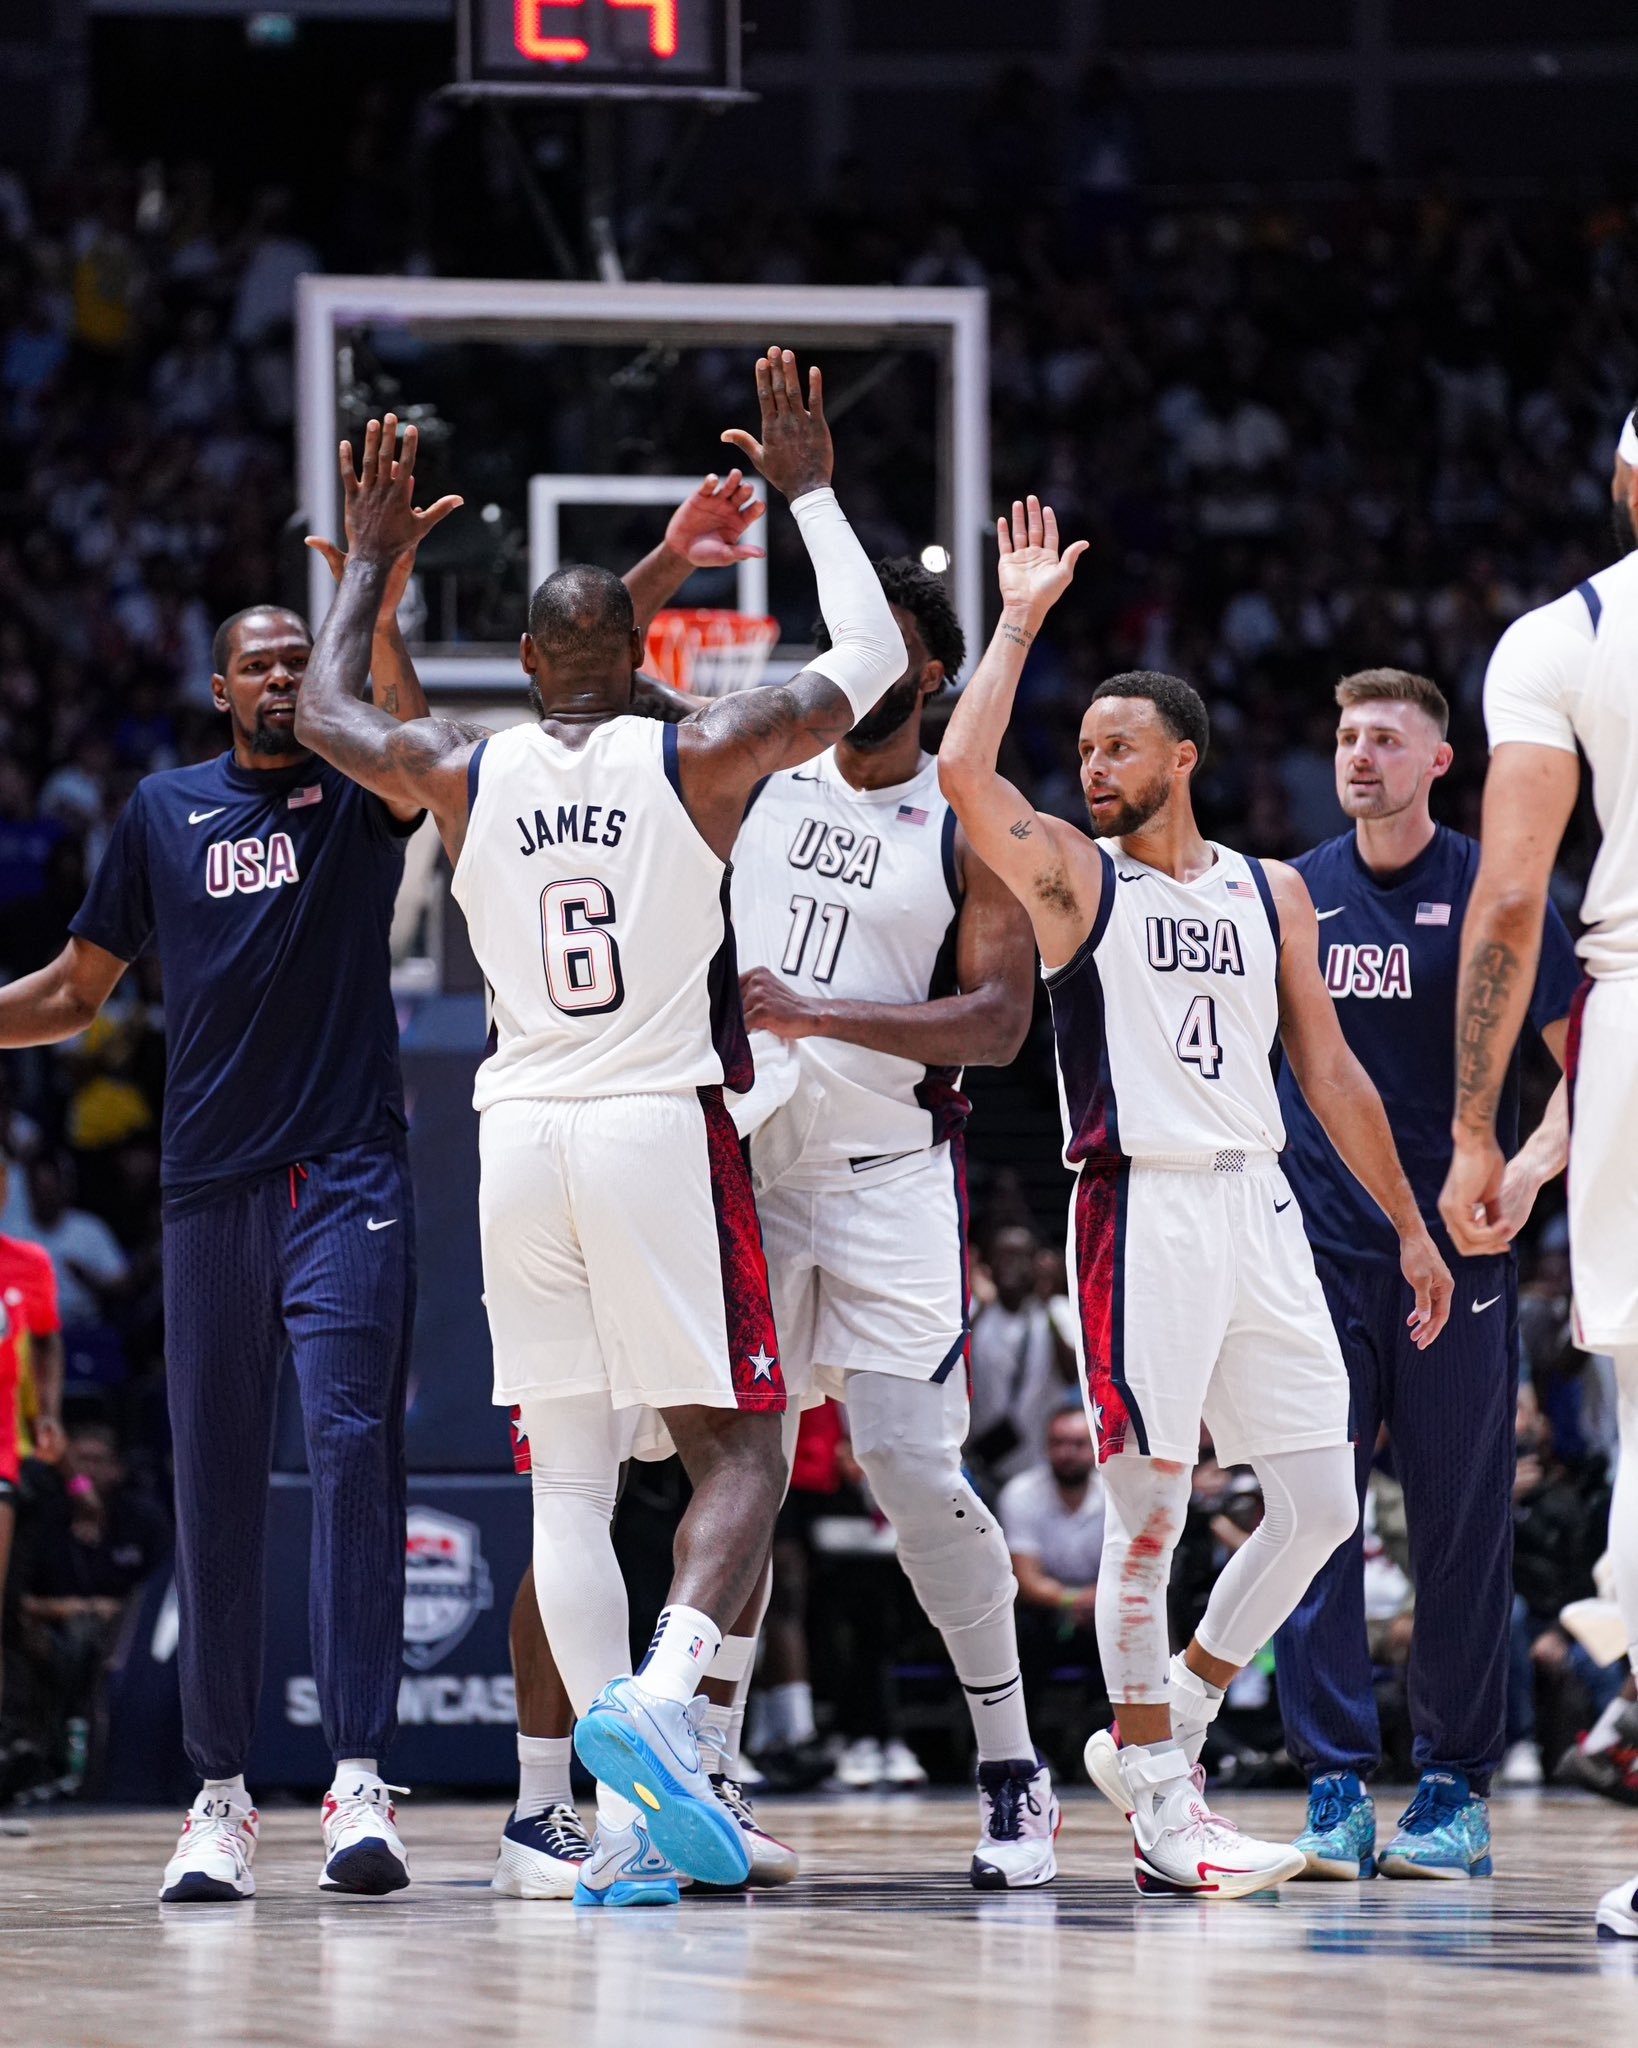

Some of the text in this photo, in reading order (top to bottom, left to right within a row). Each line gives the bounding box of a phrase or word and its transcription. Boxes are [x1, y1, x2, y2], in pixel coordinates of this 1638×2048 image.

[516, 804, 627, 856] JAMES
[788, 817, 881, 889] USA
[206, 832, 299, 898] USA
[540, 877, 625, 1017] 6
[781, 894, 849, 984] 11
[1146, 917, 1245, 976] USA
[1325, 944, 1412, 999] USA
[1176, 996, 1223, 1079] 4
